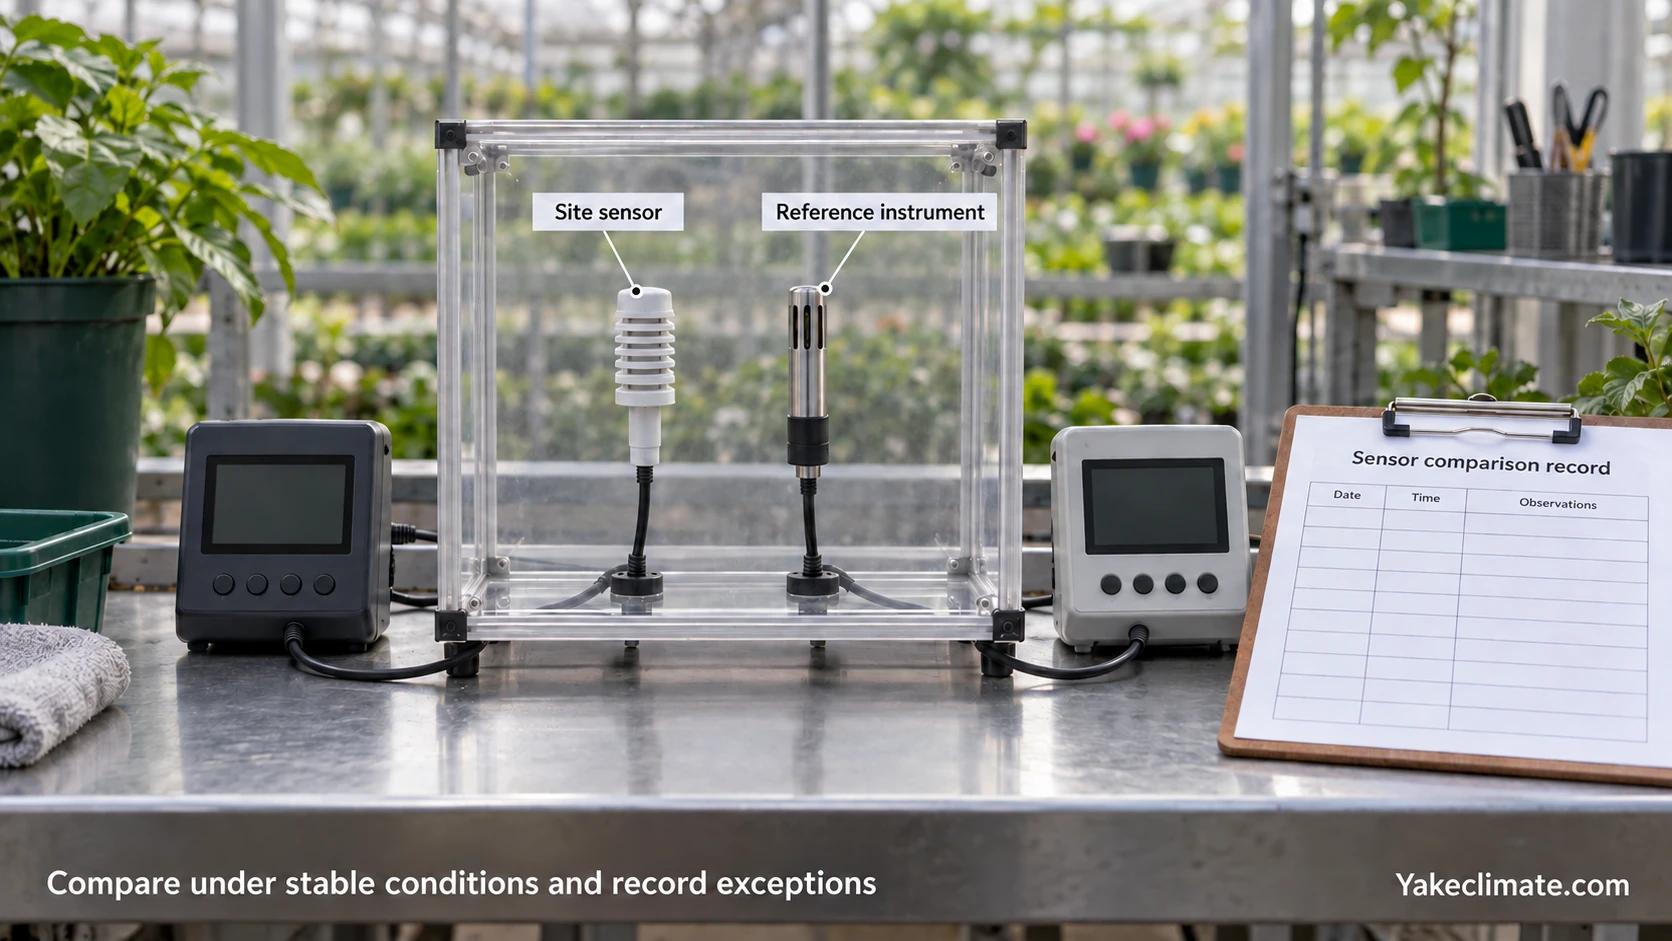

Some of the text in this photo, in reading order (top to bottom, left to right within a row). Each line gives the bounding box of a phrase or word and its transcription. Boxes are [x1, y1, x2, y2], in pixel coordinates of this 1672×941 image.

[1351, 450, 1611, 476] Sensor comparison record
[1333, 489, 1362, 500] Date
[1411, 492, 1441, 503] Time
[1519, 497, 1598, 510] Observations
